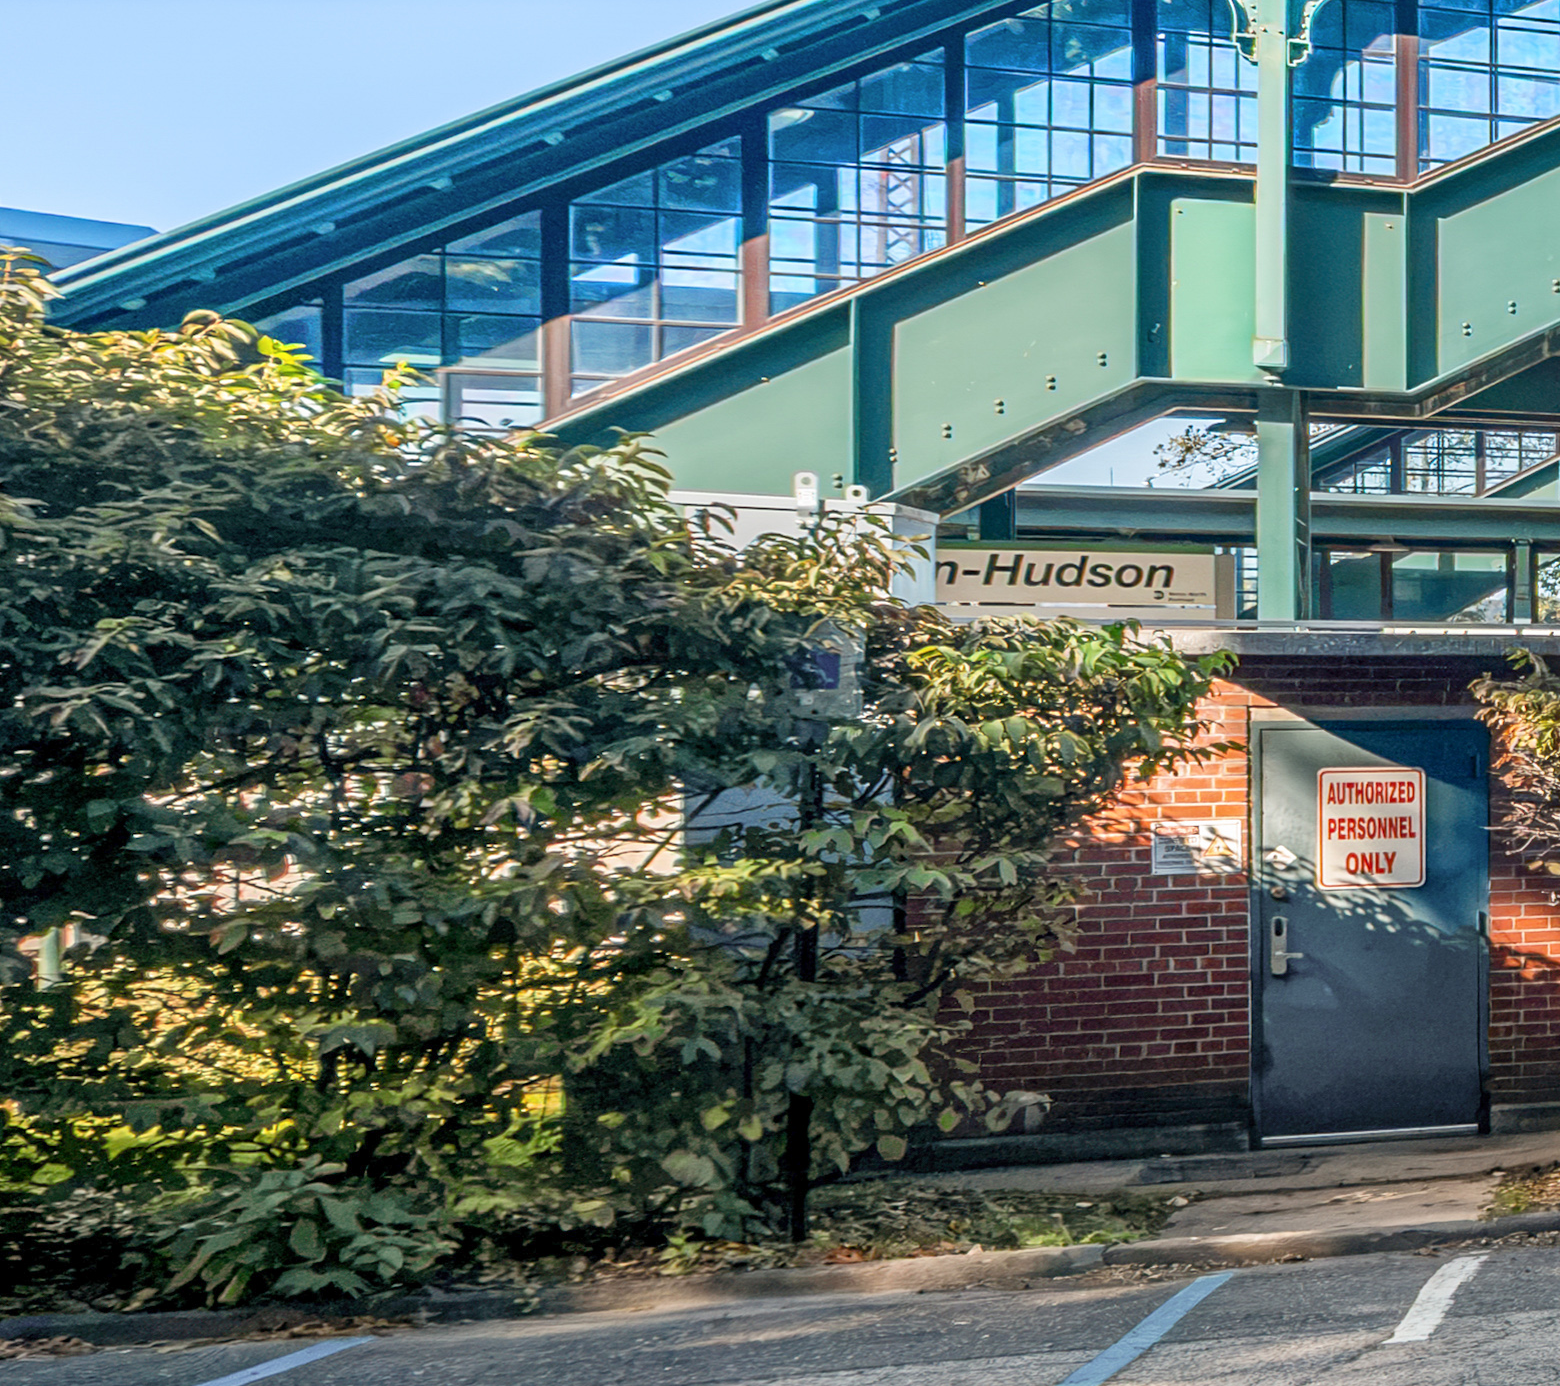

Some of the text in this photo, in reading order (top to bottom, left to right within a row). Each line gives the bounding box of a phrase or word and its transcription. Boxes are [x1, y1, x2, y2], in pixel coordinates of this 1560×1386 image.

[1327, 781, 1416, 805] AUTHORIZED
[1327, 816, 1417, 841] PERSONNEL
[1345, 851, 1397, 876] ONLY
